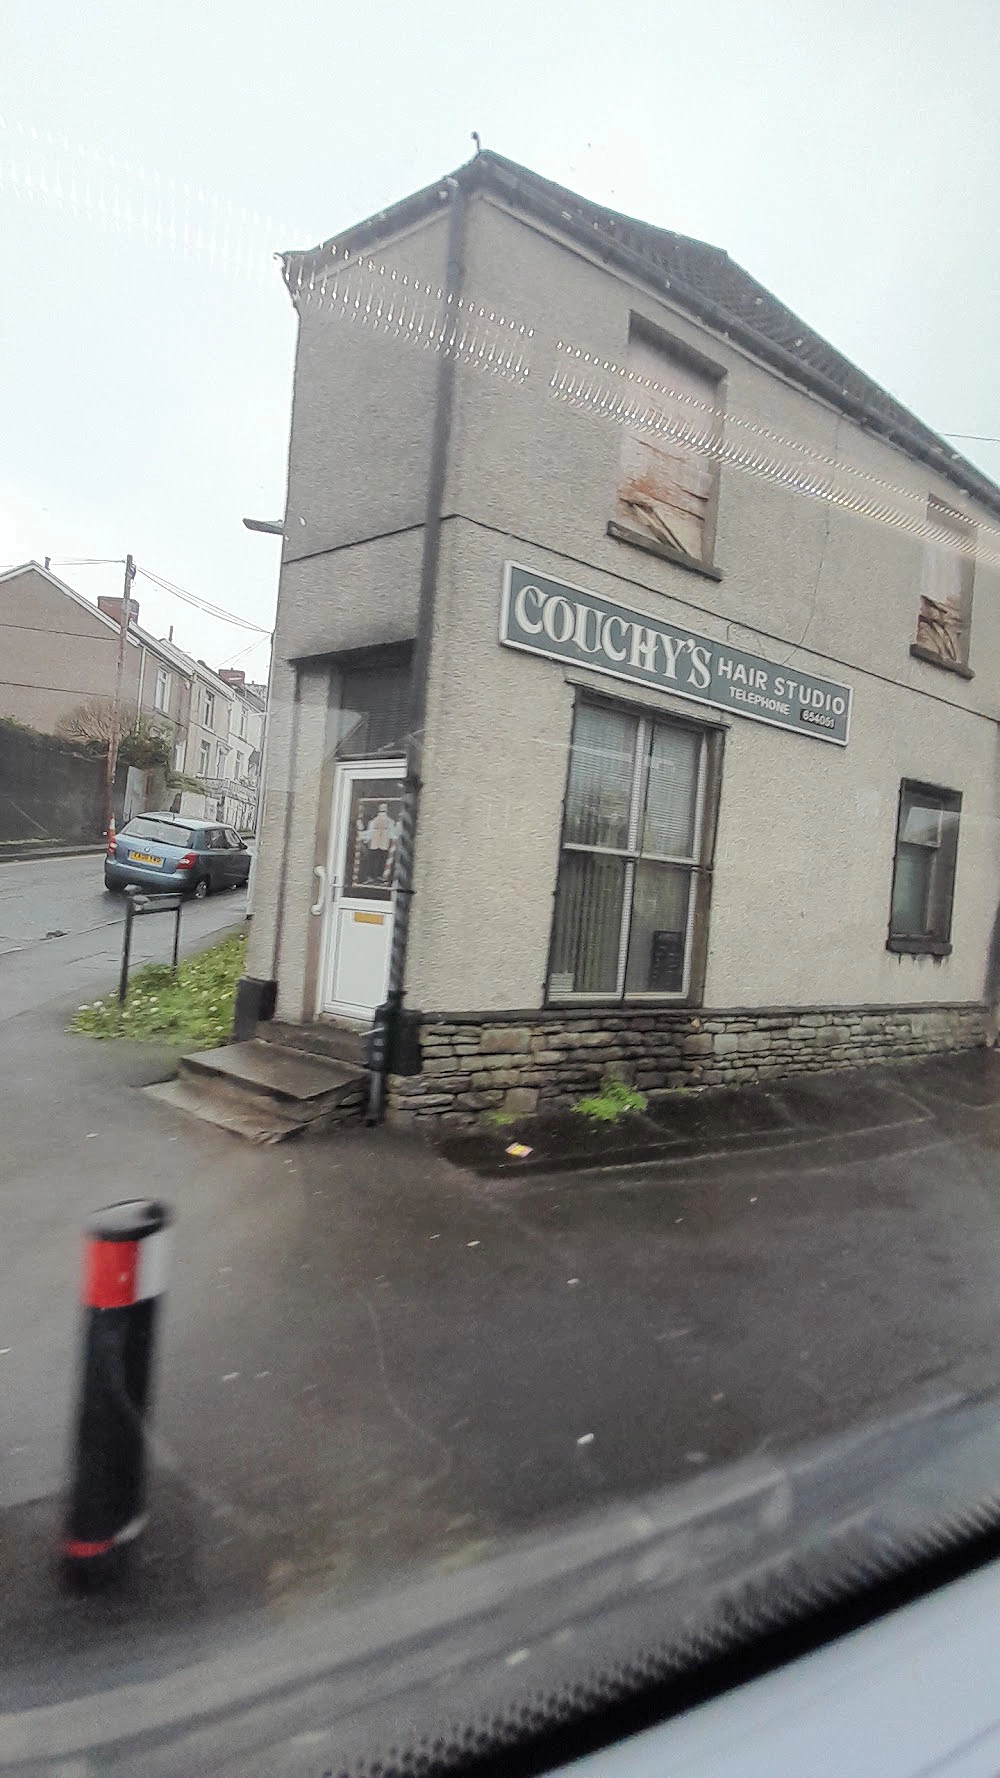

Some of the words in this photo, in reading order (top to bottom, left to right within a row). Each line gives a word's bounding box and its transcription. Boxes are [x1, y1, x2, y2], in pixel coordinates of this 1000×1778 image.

[514, 585, 713, 689] COUCHY'S
[717, 657, 768, 691] HAIR
[774, 677, 845, 715] STUDIO
[729, 686, 791, 715] TELEPHONE
